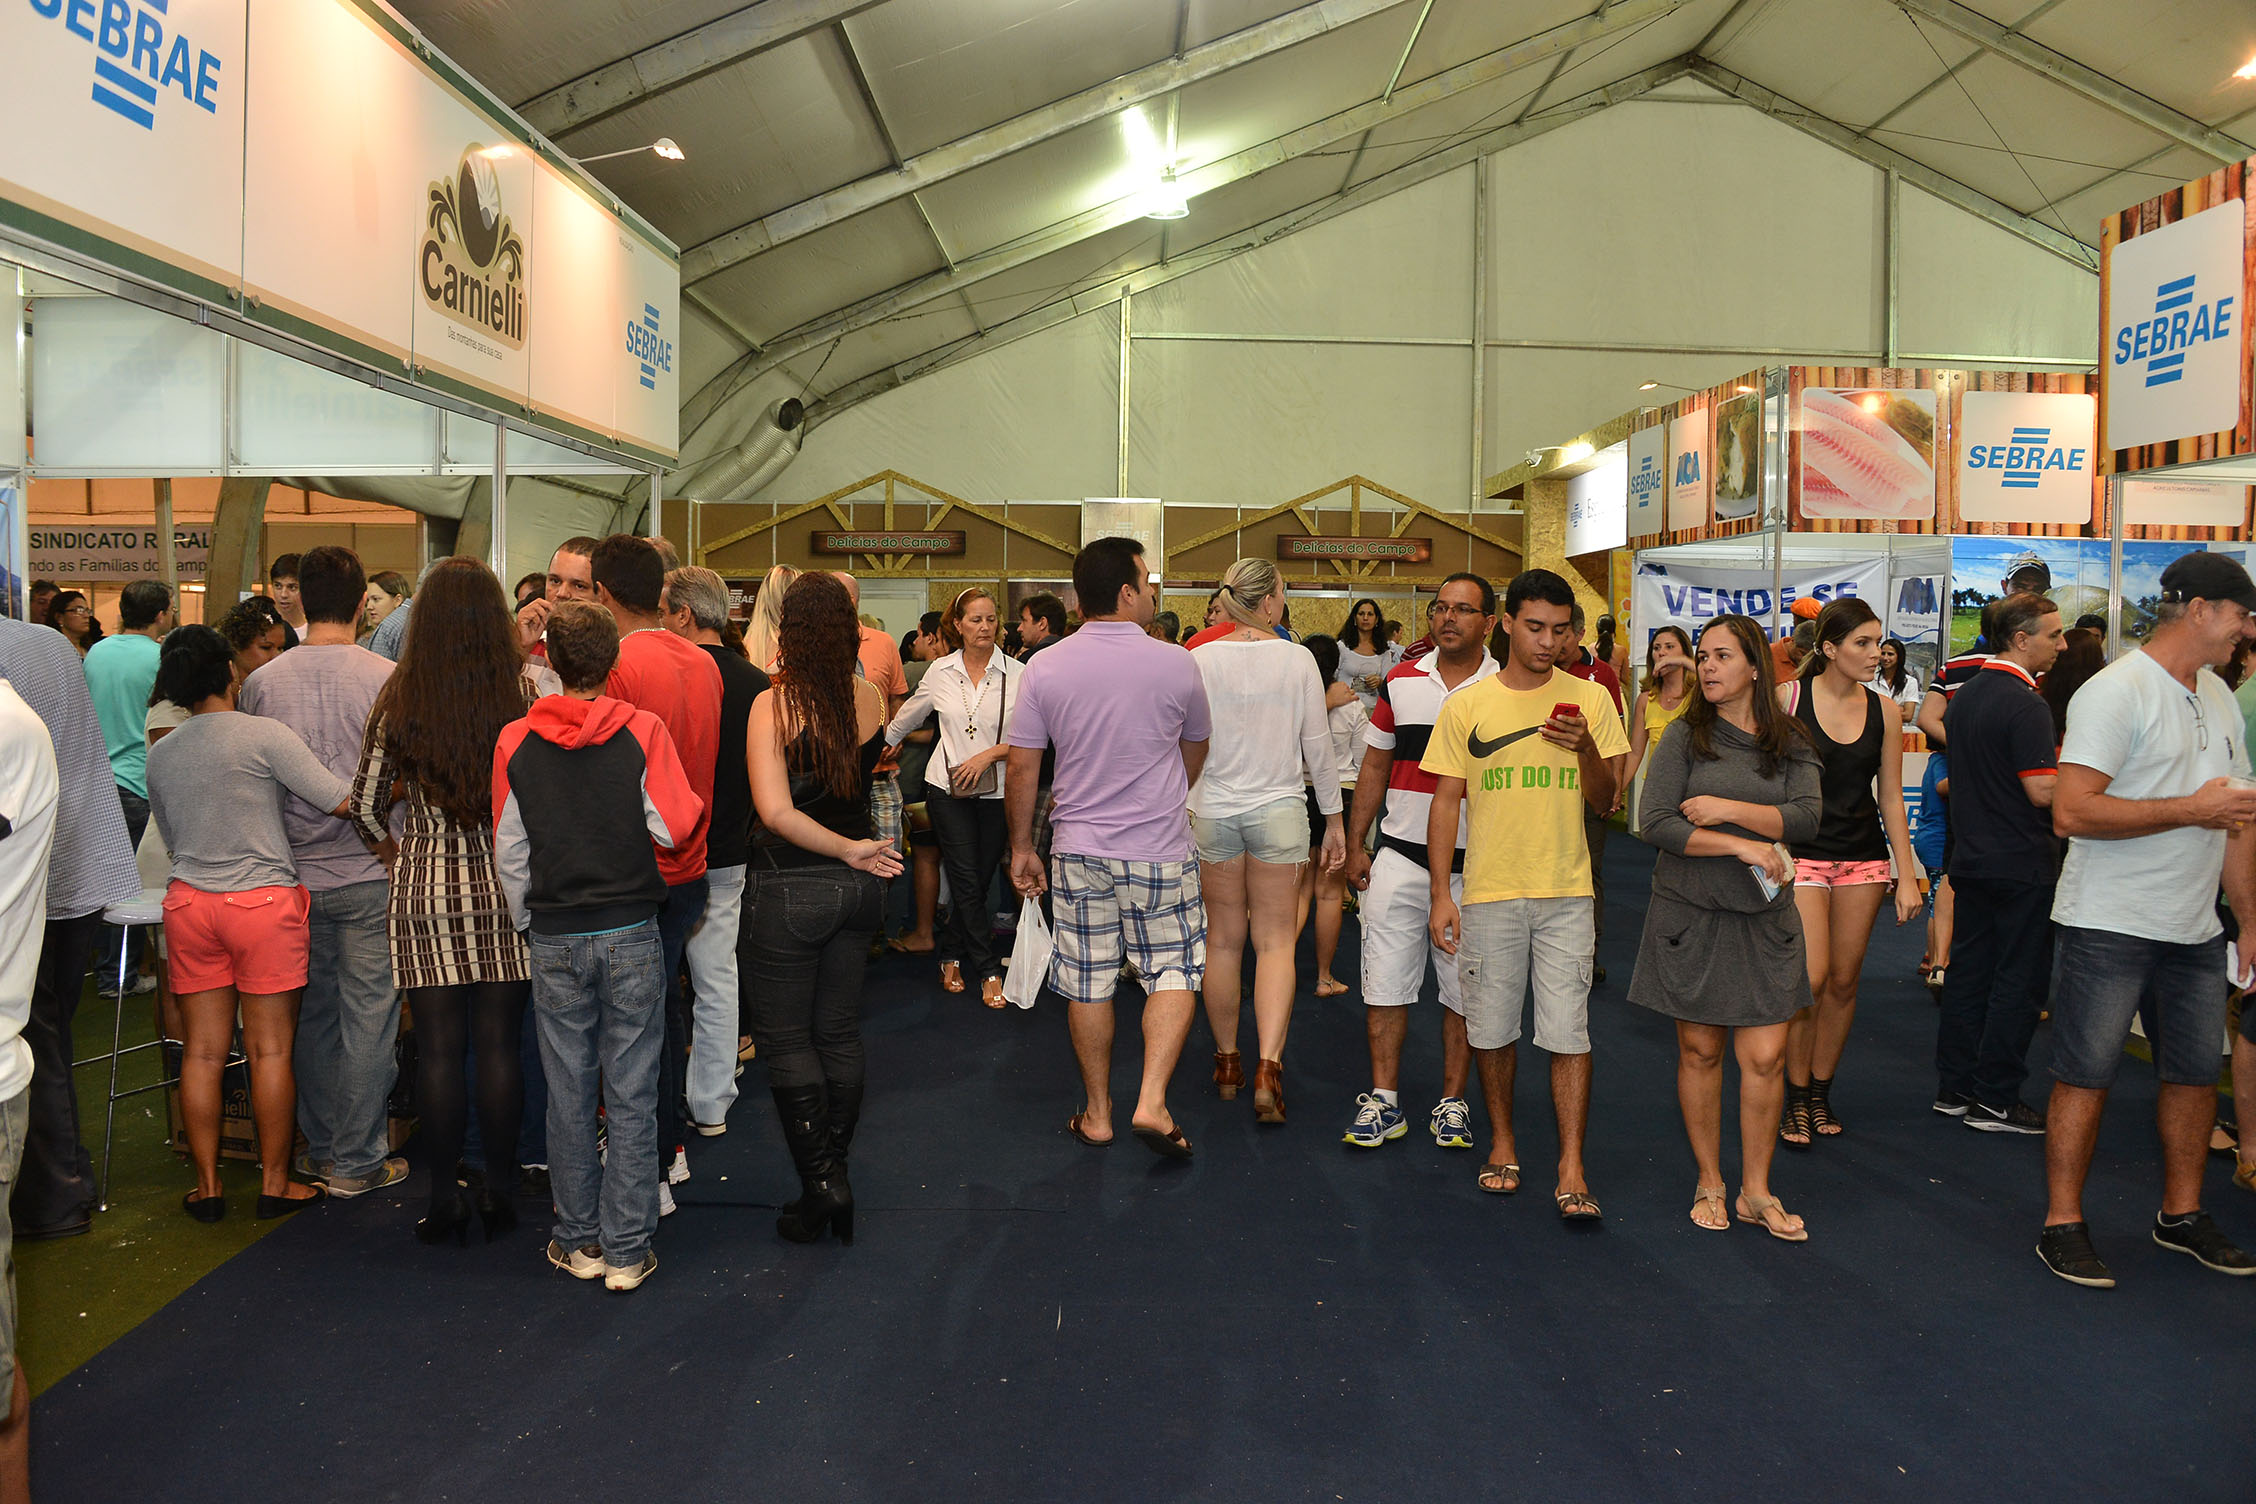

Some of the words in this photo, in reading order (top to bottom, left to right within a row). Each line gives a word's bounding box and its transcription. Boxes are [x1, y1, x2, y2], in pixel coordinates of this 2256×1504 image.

[421, 239, 523, 342] Carnielli
[2114, 296, 2234, 365] SEBRAE
[626, 320, 672, 373] SEBRAE
[1967, 445, 2086, 471] SEBRAE
[1631, 469, 1662, 495] SEBRAE
[30, 532, 137, 549] SINDICATO
[144, 532, 209, 549] RRAL
[827, 535, 878, 549] Delícias
[880, 536, 898, 549] do
[901, 536, 950, 550] Campo
[1293, 540, 1344, 554] Delícias
[1346, 541, 1364, 554] do
[1367, 542, 1417, 556] Campo
[28, 559, 55, 572] ndo
[58, 561, 75, 572] as
[80, 558, 139, 572] Famílias
[176, 561, 207, 575] amp
[729, 595, 756, 604] BRAE
[1661, 584, 1797, 616] VENDE
[1480, 766, 1514, 791] JUST
[1522, 765, 1550, 789] DO
